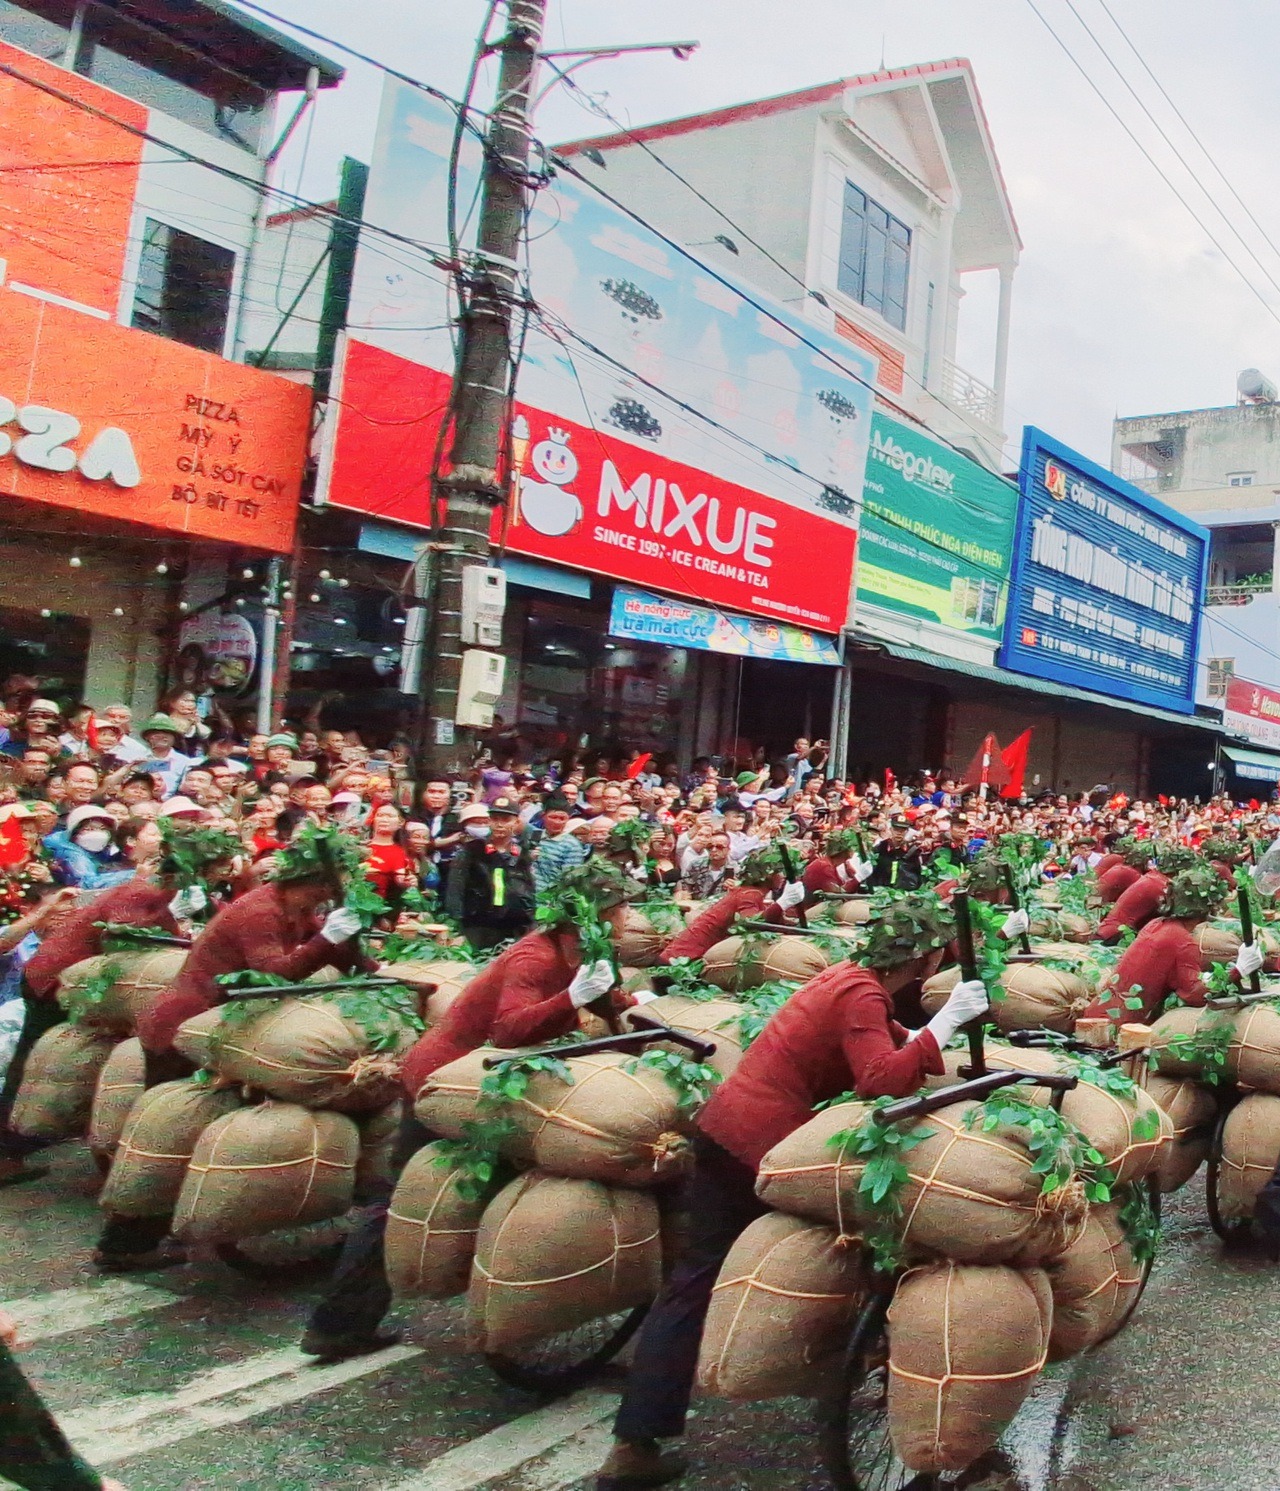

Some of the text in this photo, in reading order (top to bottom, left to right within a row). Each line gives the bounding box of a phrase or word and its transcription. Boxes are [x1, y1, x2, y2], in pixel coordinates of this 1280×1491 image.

[186, 394, 240, 426] PIZZA
[597, 459, 777, 568] MIXUE
[593, 526, 637, 551] SINCE
[672, 549, 692, 567] ICE
[694, 557, 737, 580] CREAM
[747, 571, 769, 589] TEA
[941, 534, 961, 553] NGA
